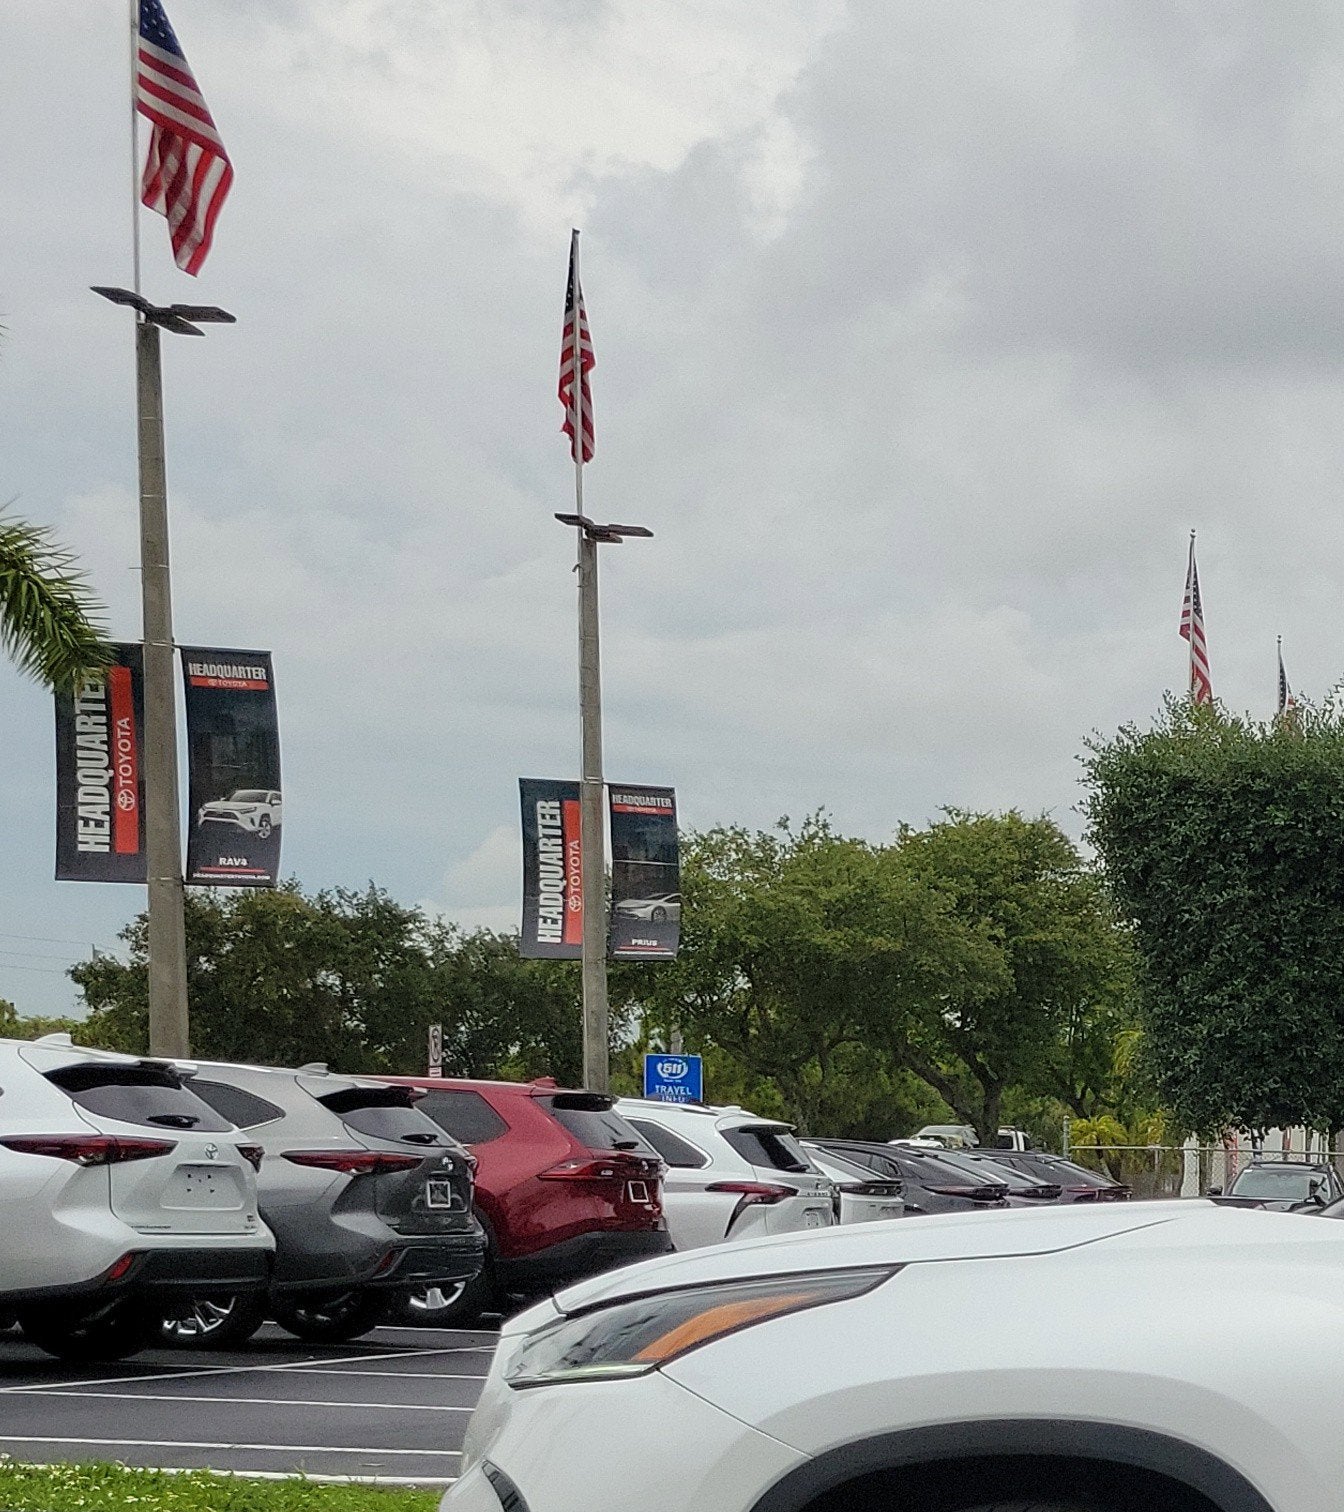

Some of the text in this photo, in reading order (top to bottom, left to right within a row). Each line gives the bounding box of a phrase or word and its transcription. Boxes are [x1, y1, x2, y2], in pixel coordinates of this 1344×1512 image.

[188, 662, 267, 680] HEADQUARTER
[117, 717, 132, 788] TOYOTA
[612, 794, 672, 808] HEADQUARTER
[219, 857, 249, 866] RAV4
[570, 840, 580, 896] TOYOTA
[537, 799, 566, 944] HEADQUARTER
[663, 1063, 682, 1074] 511
[655, 1085, 692, 1095] TRAVEL
